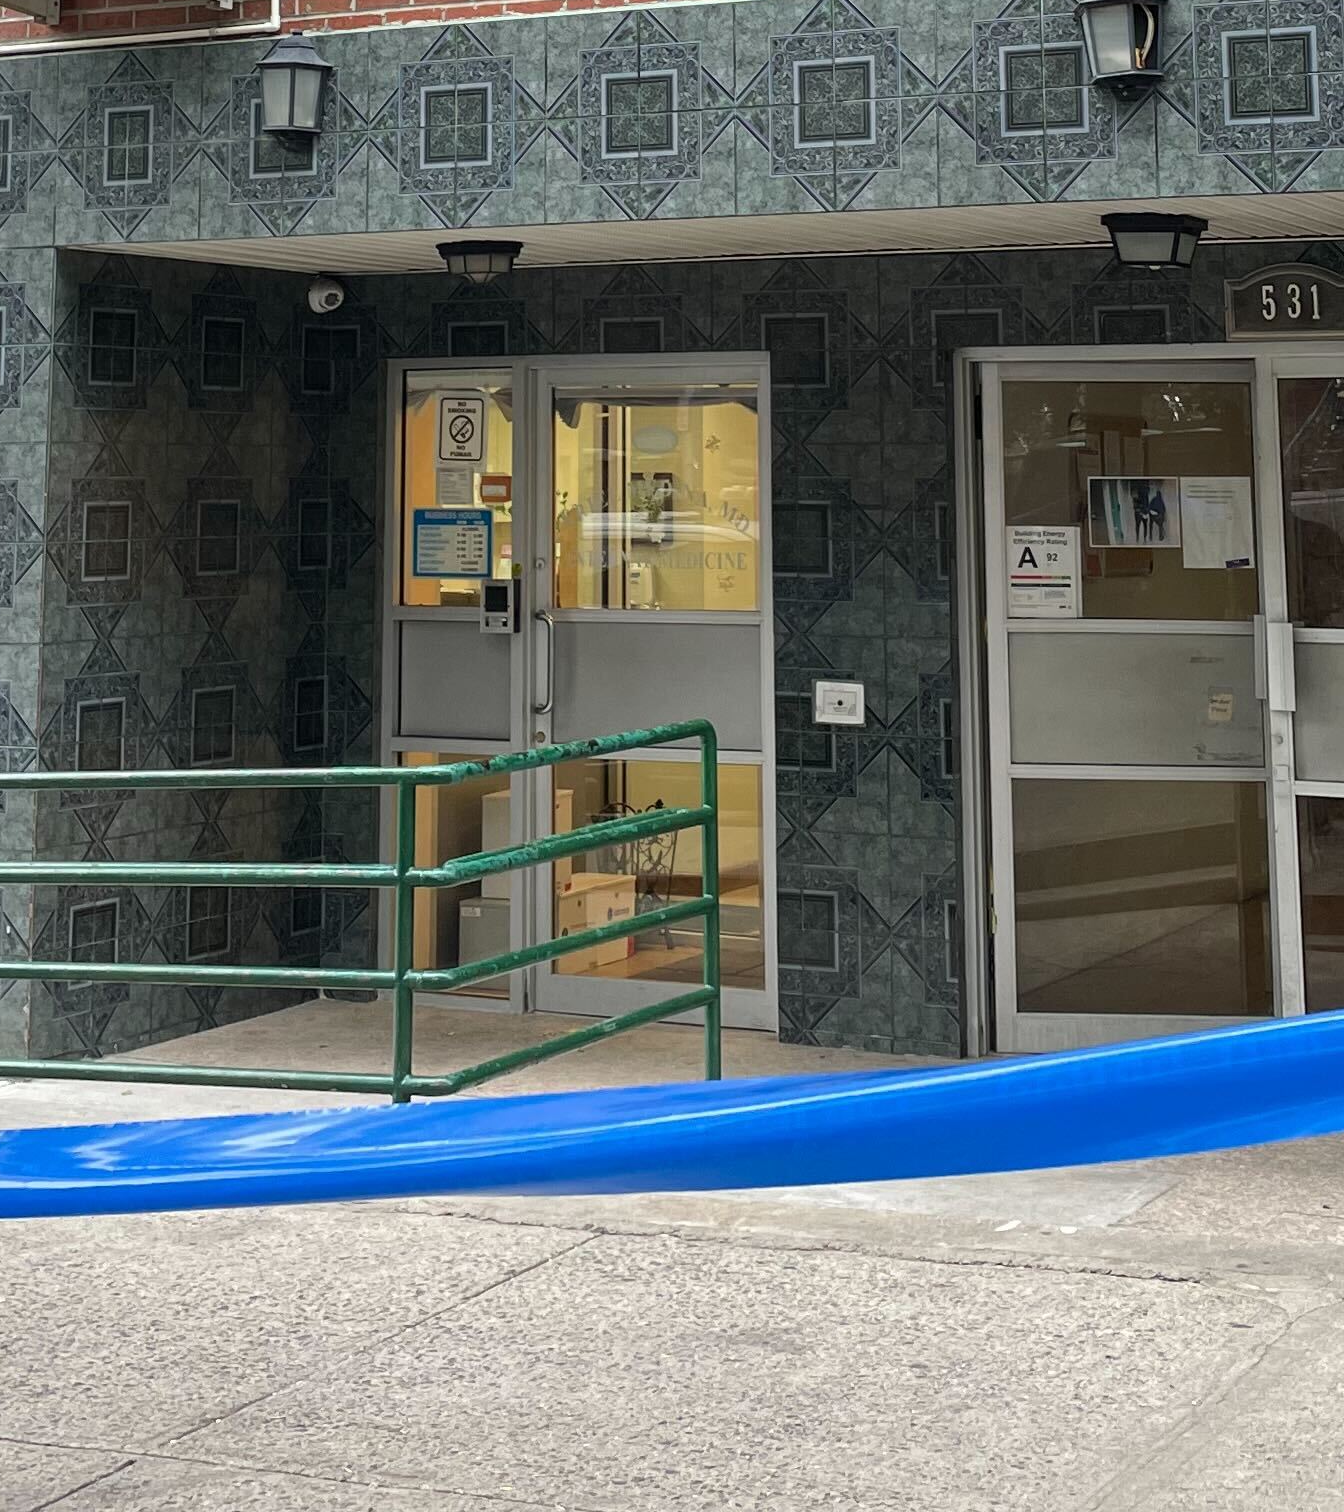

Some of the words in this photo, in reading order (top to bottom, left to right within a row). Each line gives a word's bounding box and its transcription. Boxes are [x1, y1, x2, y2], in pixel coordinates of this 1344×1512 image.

[1261, 283, 1321, 320] 531
[1017, 546, 1038, 568] A
[1046, 553, 1058, 562] 92
